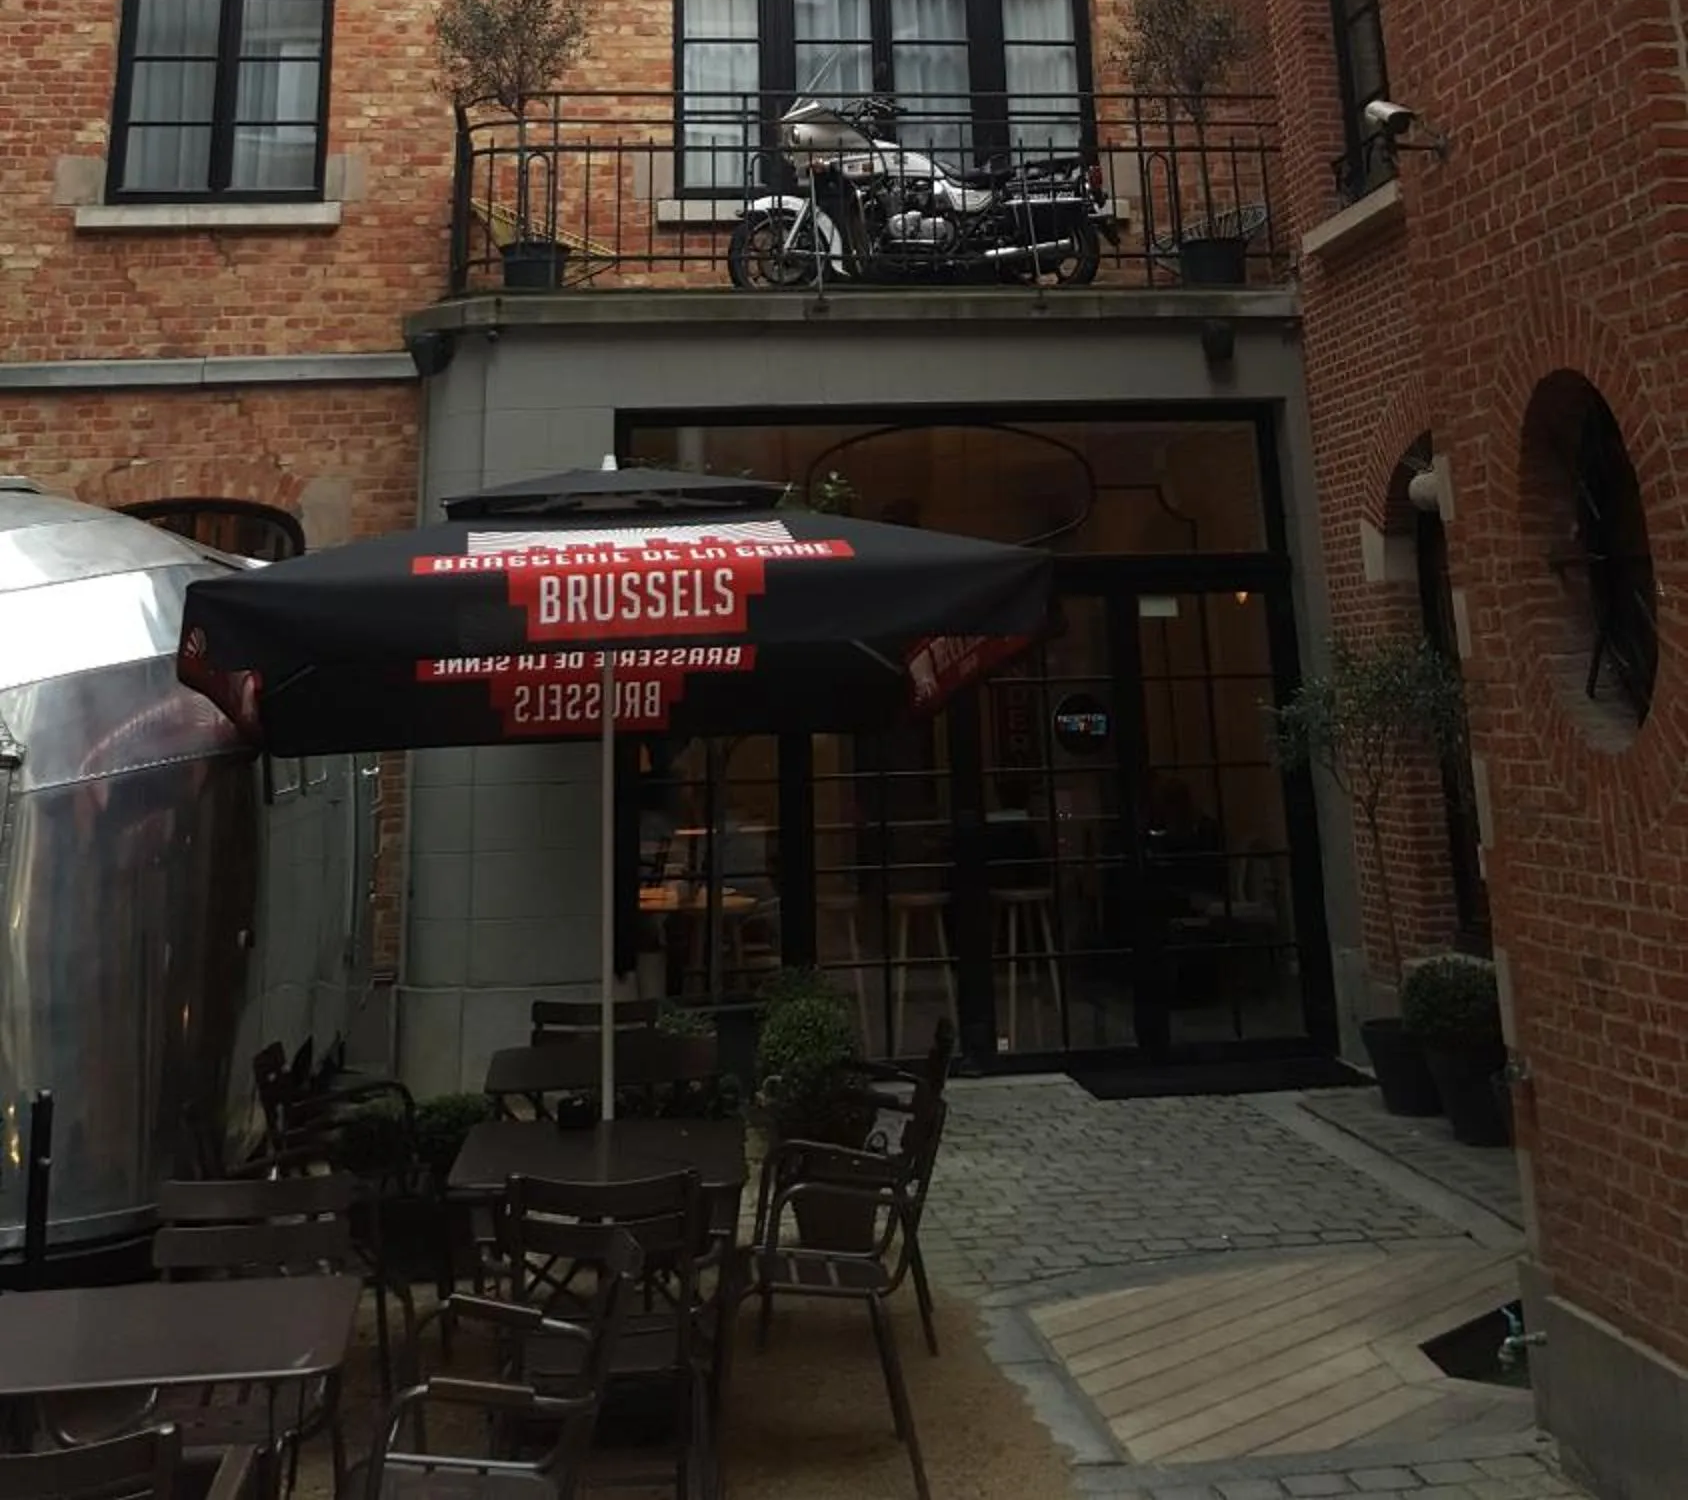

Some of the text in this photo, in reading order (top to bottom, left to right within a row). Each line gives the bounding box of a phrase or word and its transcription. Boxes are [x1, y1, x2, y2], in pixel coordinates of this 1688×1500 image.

[433, 542, 833, 571] BRASSERIE DE LA SENNE
[539, 567, 735, 624] BRUSSELS
